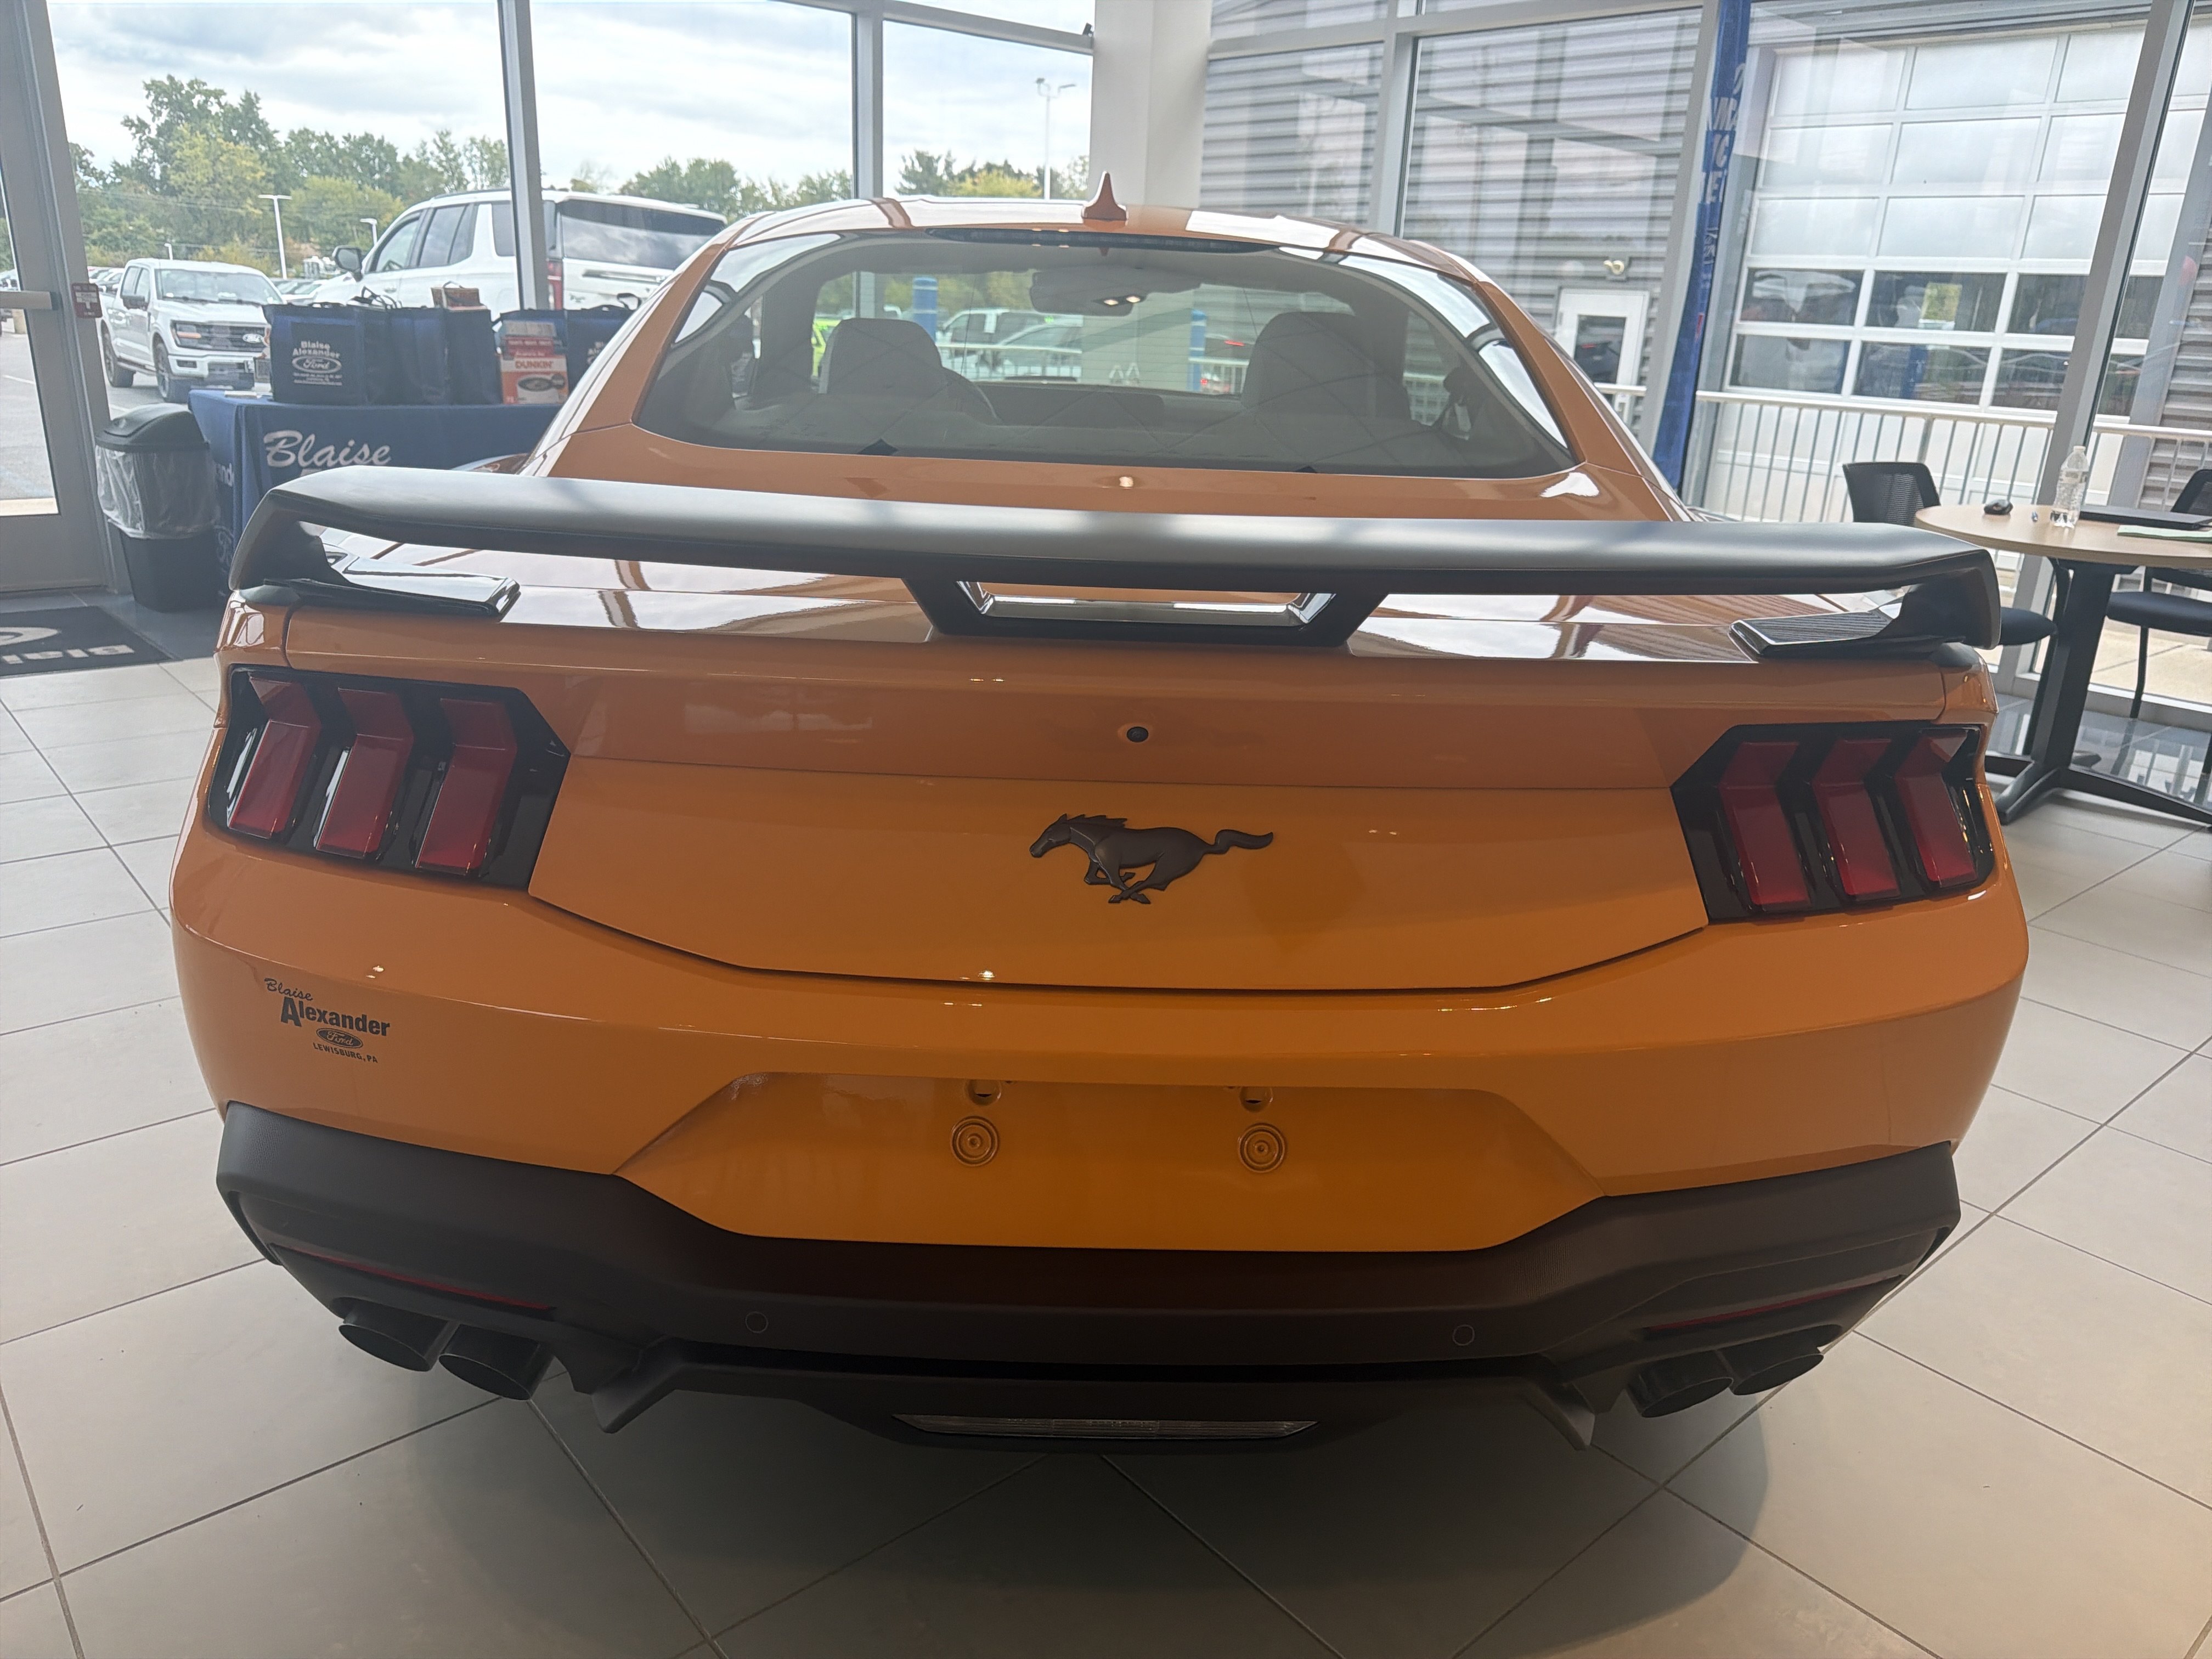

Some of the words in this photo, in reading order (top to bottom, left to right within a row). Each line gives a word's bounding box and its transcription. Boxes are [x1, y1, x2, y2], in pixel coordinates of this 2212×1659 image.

[263, 430, 392, 466] Blaise
[264, 978, 313, 1001] Blaise
[280, 996, 391, 1036] Alexander
